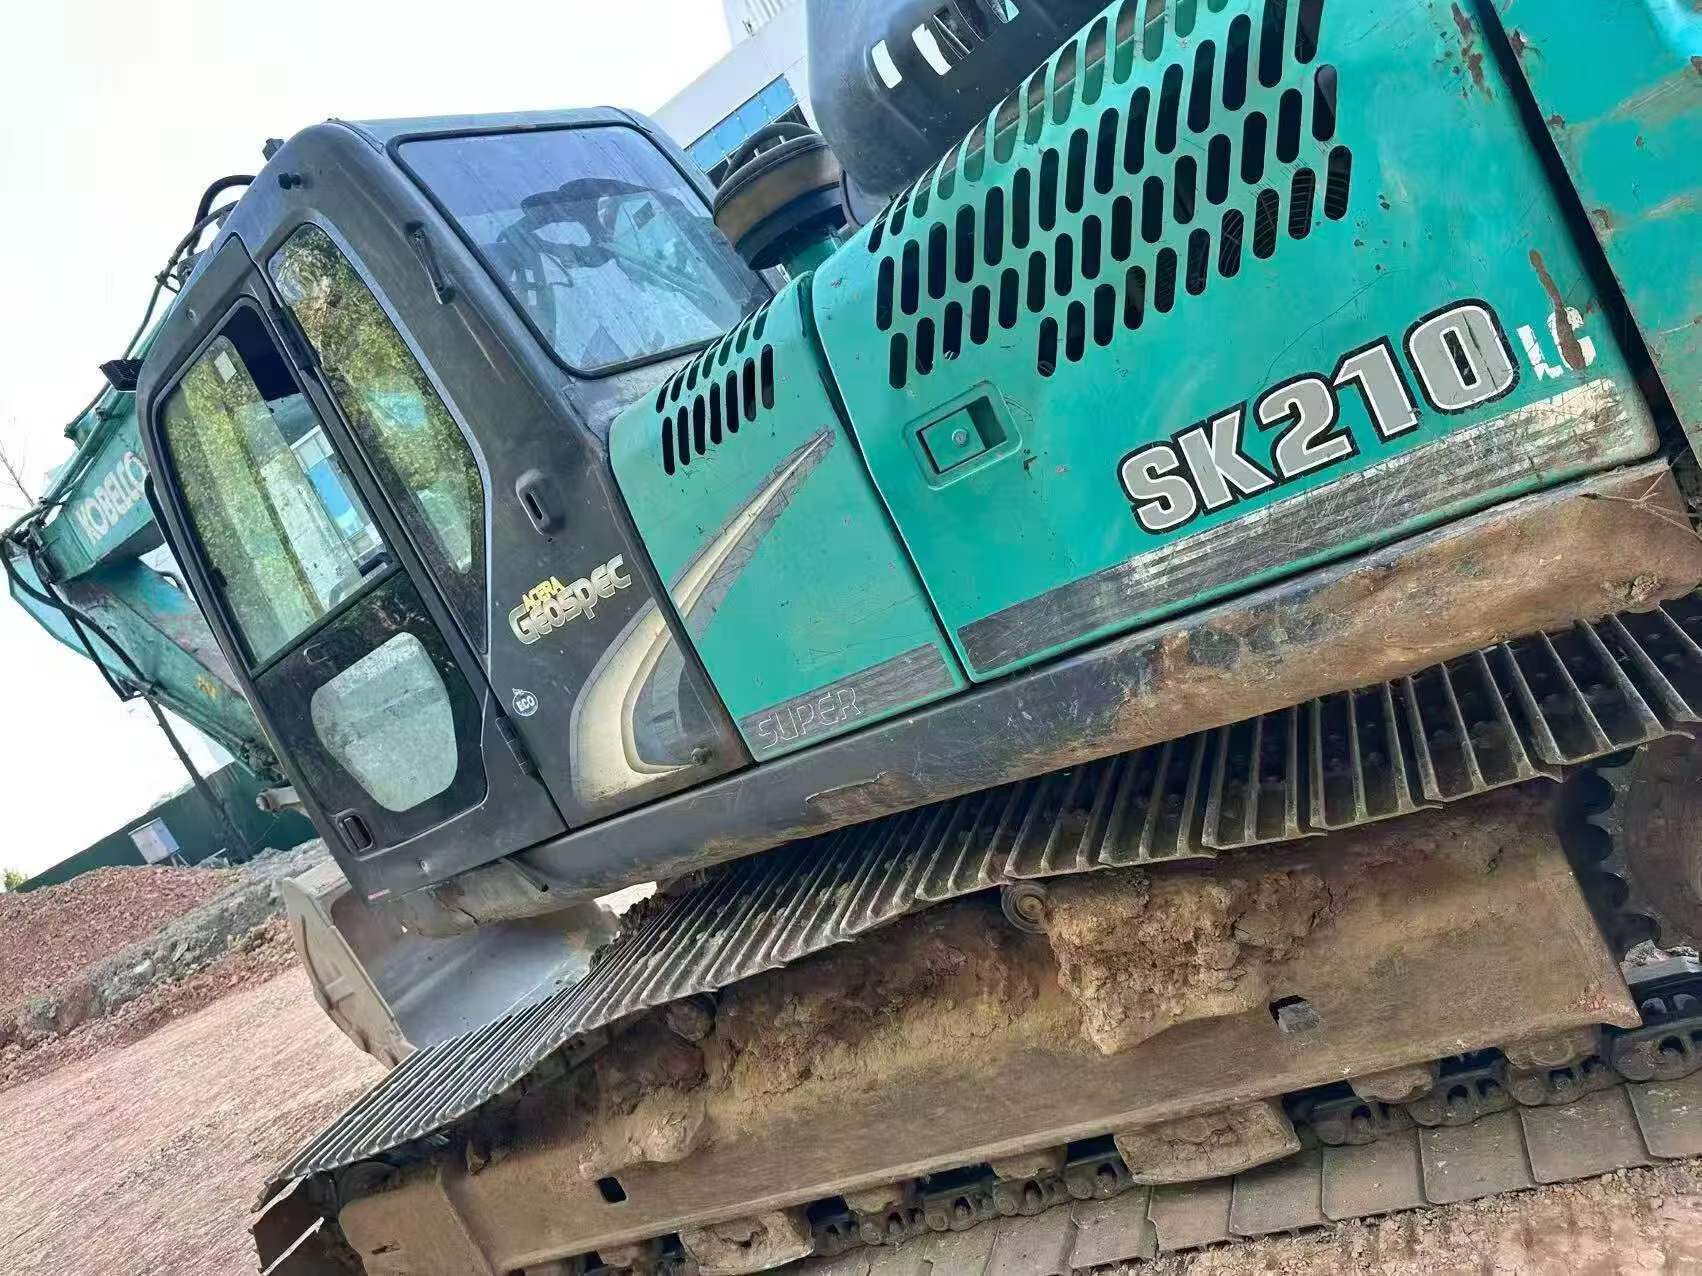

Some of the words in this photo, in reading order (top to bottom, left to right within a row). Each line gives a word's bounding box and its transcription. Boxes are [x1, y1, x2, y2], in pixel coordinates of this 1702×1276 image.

[1118, 298, 1520, 535] SK210
[74, 451, 148, 546] KOBELCO
[521, 575, 566, 613] ACERA
[515, 695, 536, 712] ECO
[758, 687, 862, 750] SUPER
